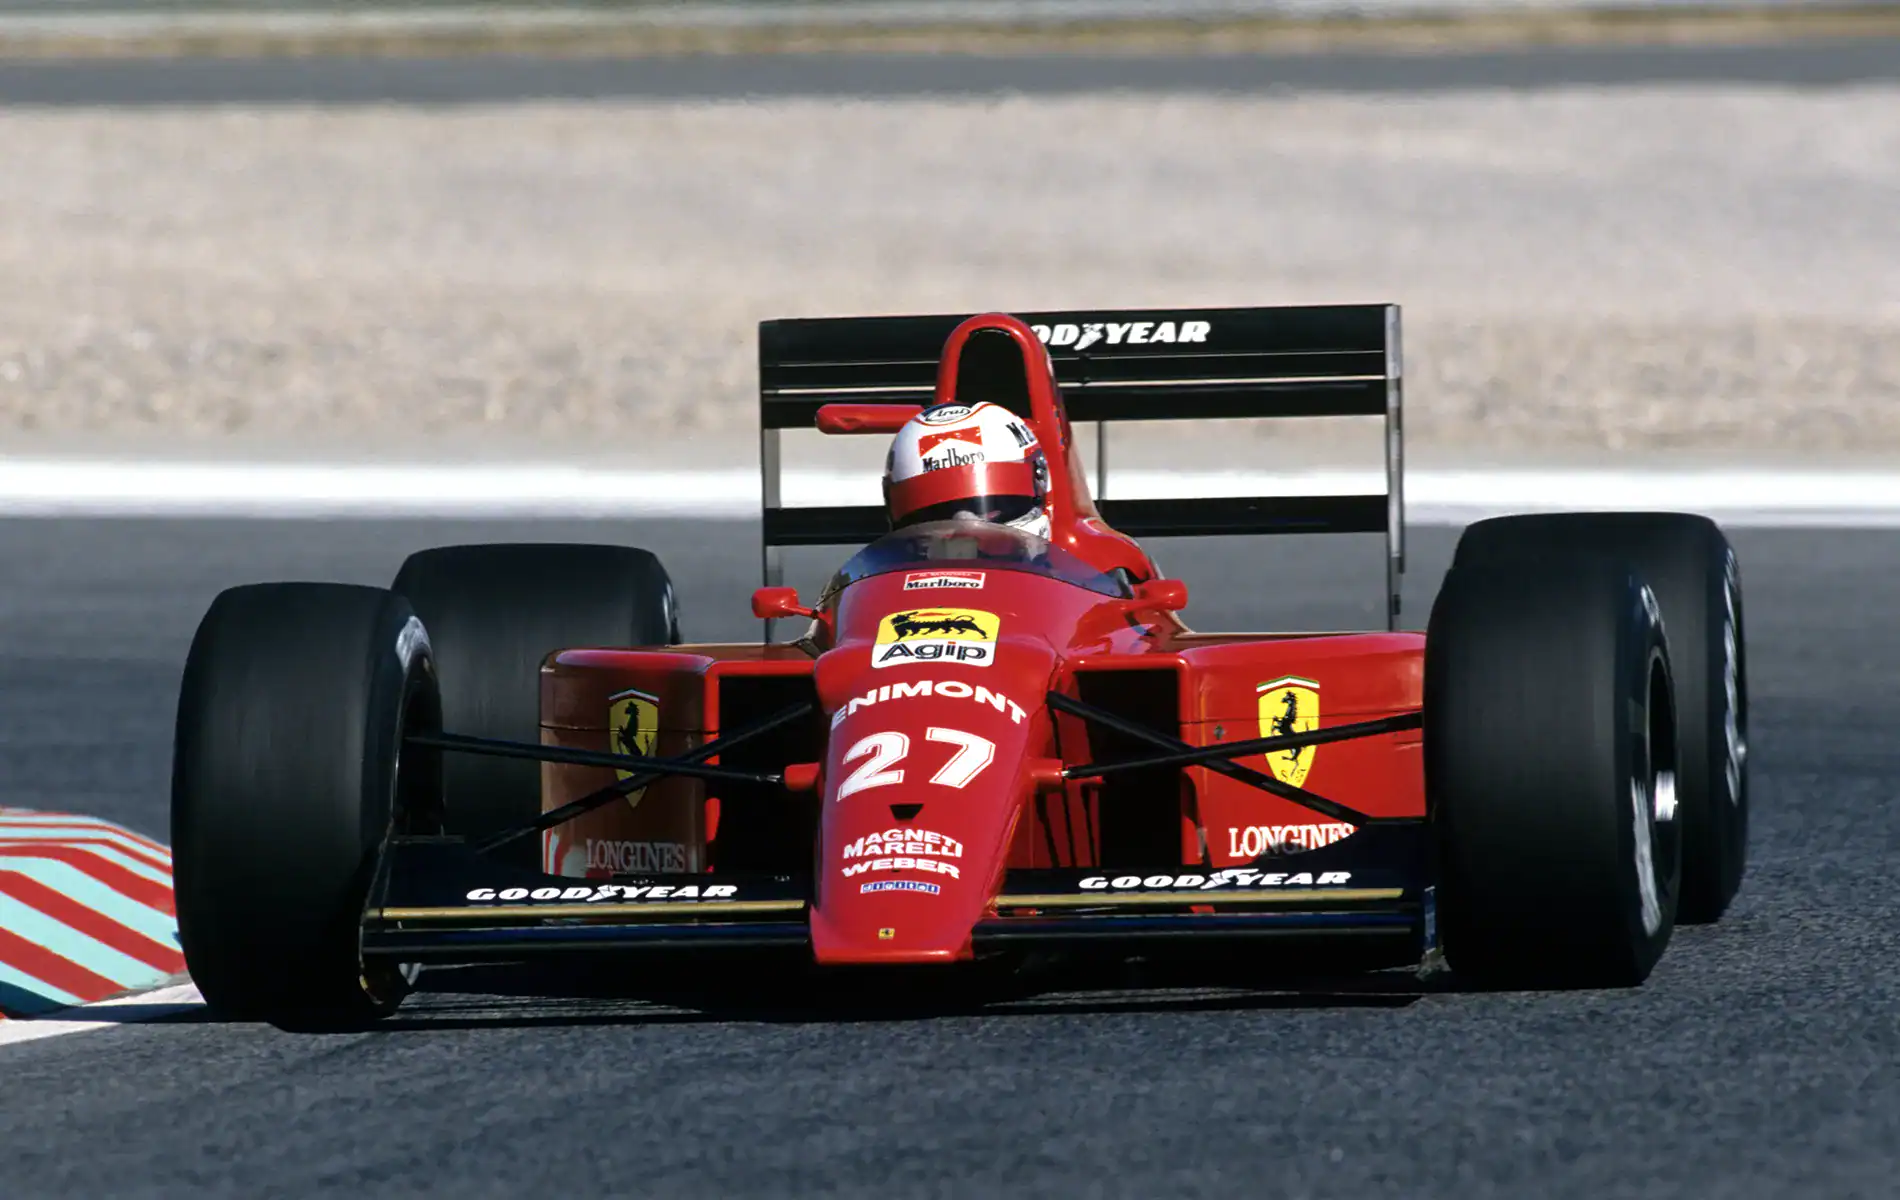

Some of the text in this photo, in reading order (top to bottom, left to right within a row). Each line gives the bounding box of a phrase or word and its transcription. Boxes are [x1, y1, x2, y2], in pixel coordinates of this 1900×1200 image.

[1030, 321, 1211, 350] ODYEAR
[922, 447, 985, 473] Marlboro
[906, 579, 980, 589] Marlboro
[878, 641, 987, 662] Agip
[831, 680, 1027, 731] ENIMONT
[836, 727, 996, 802] 27
[843, 828, 963, 855] MAGNETI
[843, 839, 963, 858] MARELLI
[586, 839, 686, 873] LONGINES
[842, 857, 960, 879] WEBER
[1079, 869, 1352, 889] GOODYEAR
[466, 885, 738, 902] GOODYEAR
[862, 881, 938, 893] digital
